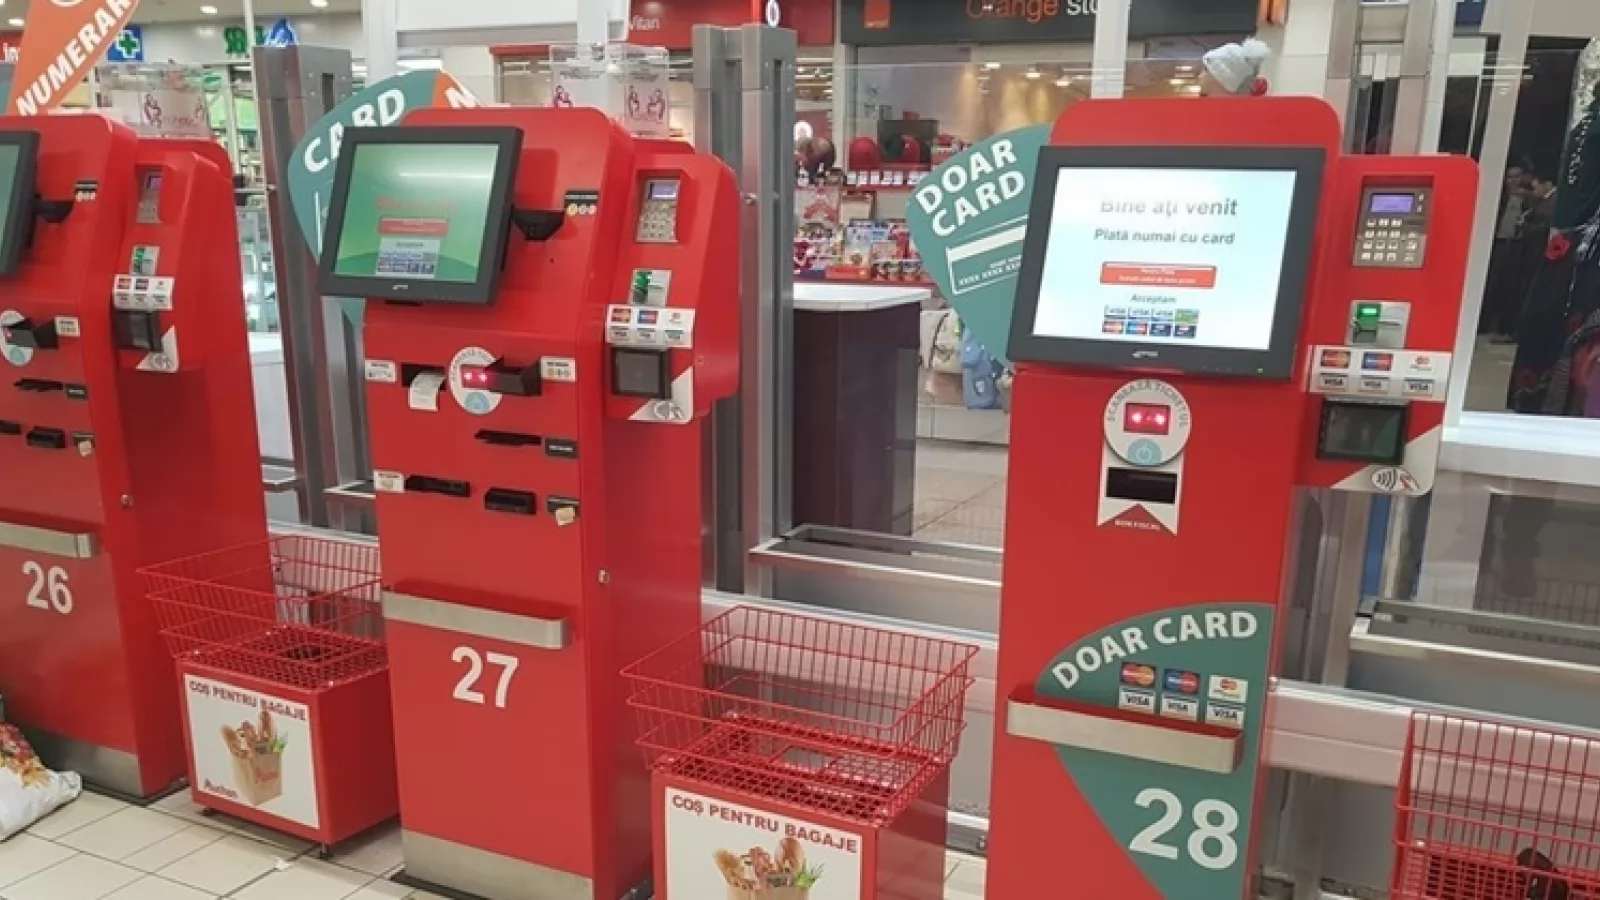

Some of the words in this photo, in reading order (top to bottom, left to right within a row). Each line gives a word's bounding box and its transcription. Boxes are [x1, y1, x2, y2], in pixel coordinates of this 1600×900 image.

[965, 0, 1059, 22] Orange
[304, 88, 405, 172] CARD
[915, 138, 1017, 215] DOAR
[932, 170, 1026, 237] CARD
[1186, 198, 1238, 216] venit
[1132, 231, 1176, 243] numai
[1179, 234, 1198, 243] cu
[1200, 232, 1236, 245] card
[22, 560, 73, 615] 26
[452, 646, 519, 708] 27
[1052, 627, 1149, 690] DOAR
[1153, 610, 1258, 644] CARD
[212, 686, 257, 708] PENTRU
[709, 803, 779, 832] PENTRU
[784, 822, 858, 853] BAGAJE
[1129, 788, 1239, 870] 28
